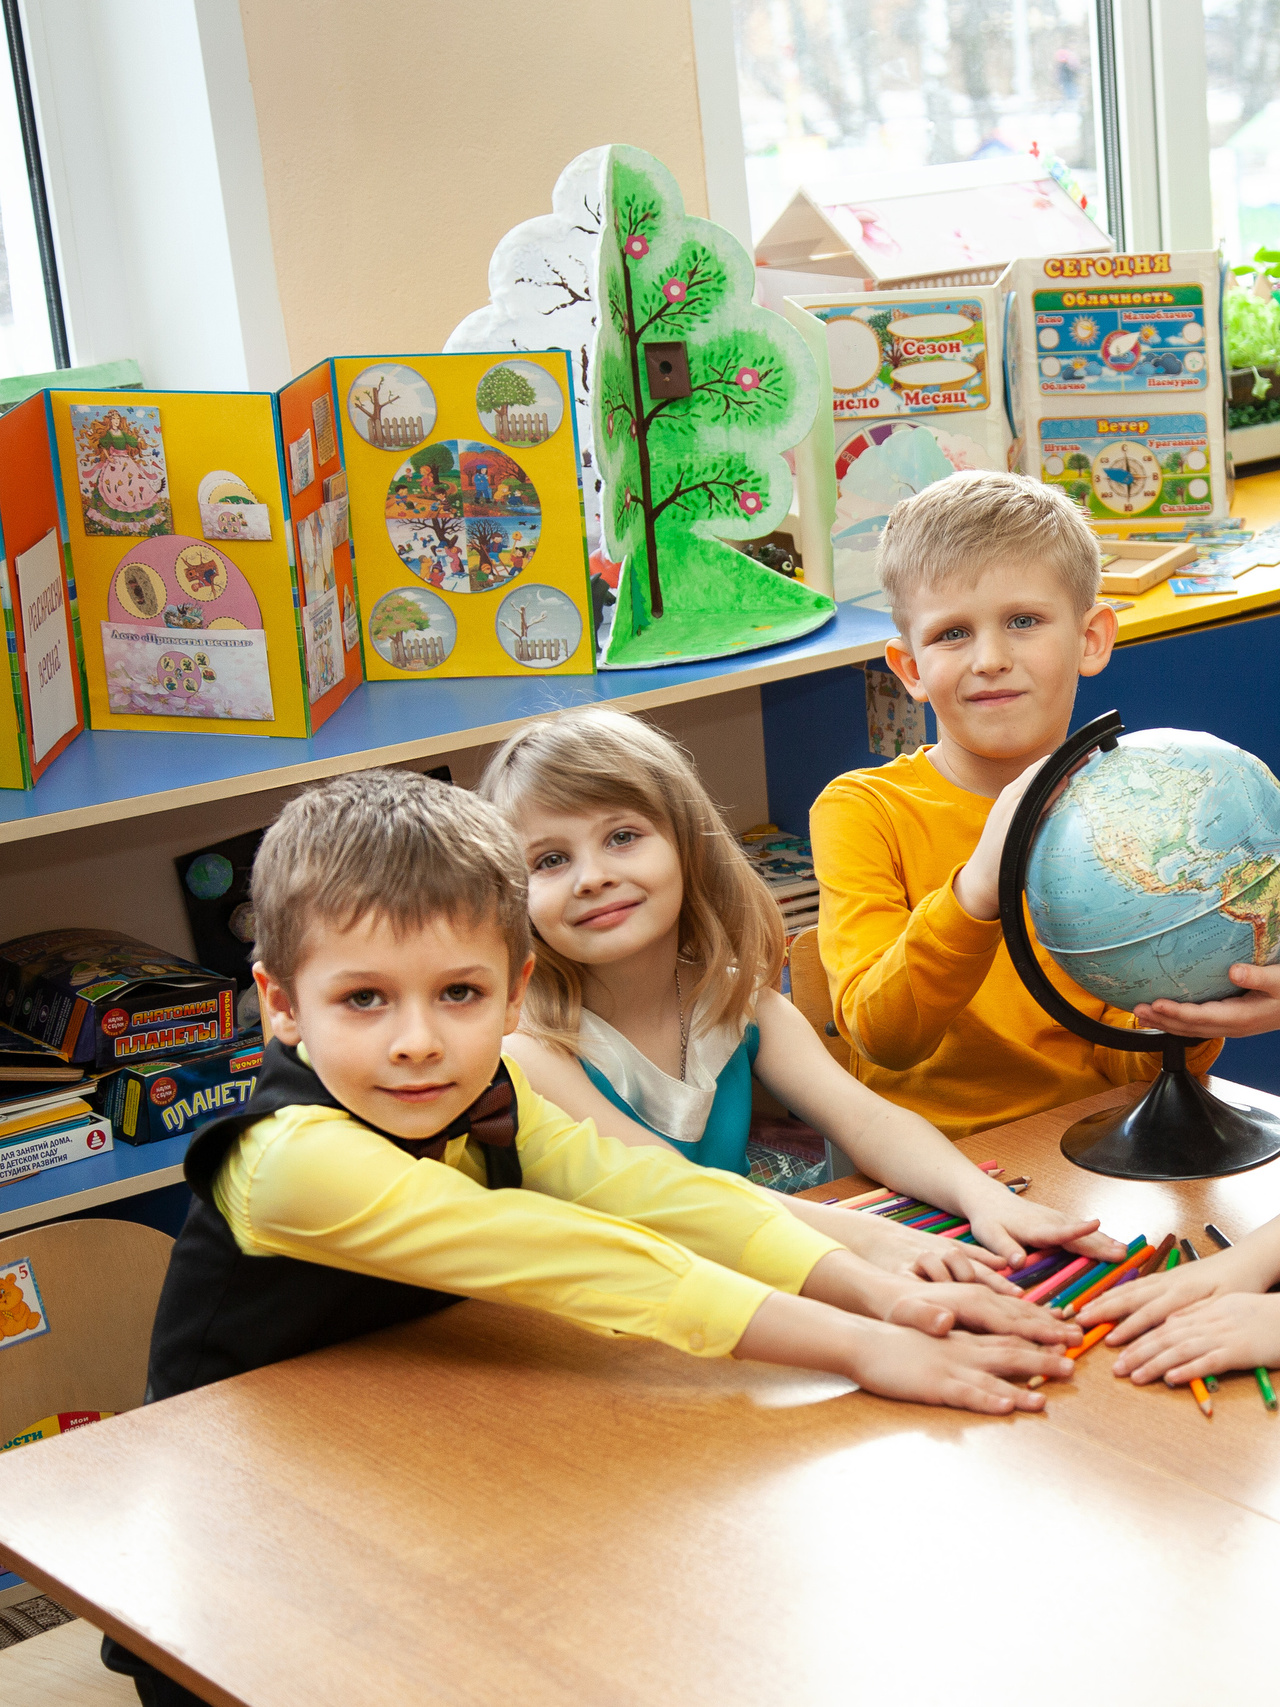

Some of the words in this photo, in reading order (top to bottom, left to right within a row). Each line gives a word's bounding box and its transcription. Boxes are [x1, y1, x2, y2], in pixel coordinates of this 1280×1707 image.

[1044, 253, 1171, 278] СЕГОДНЯ
[1062, 291, 1175, 307] Облачность
[1037, 316, 1063, 324] Ясно
[1123, 311, 1194, 321] Малооблачно
[903, 340, 962, 356] Сезон
[1041, 382, 1086, 391] Облачно
[1147, 378, 1200, 387] Пасмурно
[833, 397, 879, 411] исло
[904, 391, 967, 406] Месяц
[1097, 419, 1149, 435] Ветер
[1044, 444, 1080, 452] Штиль
[1148, 439, 1207, 449] Ураганный
[1161, 503, 1210, 513] Сильный
[111, 630, 140, 641] Лото
[132, 999, 218, 1027] АНАТОМИЯ
[115, 1020, 218, 1057] ПЛАНЕТЫ
[237, 1057, 263, 1070] BONDI
[1, 1151, 15, 1161] ДЛЯ
[16, 1141, 49, 1157] ЗАНЯТИЙ
[50, 1136, 73, 1149] ДОМА,
[6, 1154, 39, 1169] ДЕТСКОМ
[40, 1148, 58, 1158] САДУ
[0, 1166, 31, 1178] СТУДИЯХ
[32, 1154, 68, 1169] РАЗВИТИЯ
[18, 1265, 28, 1279] 5
[70, 1416, 89, 1426] Мои
[0, 1430, 43, 1451] ости
